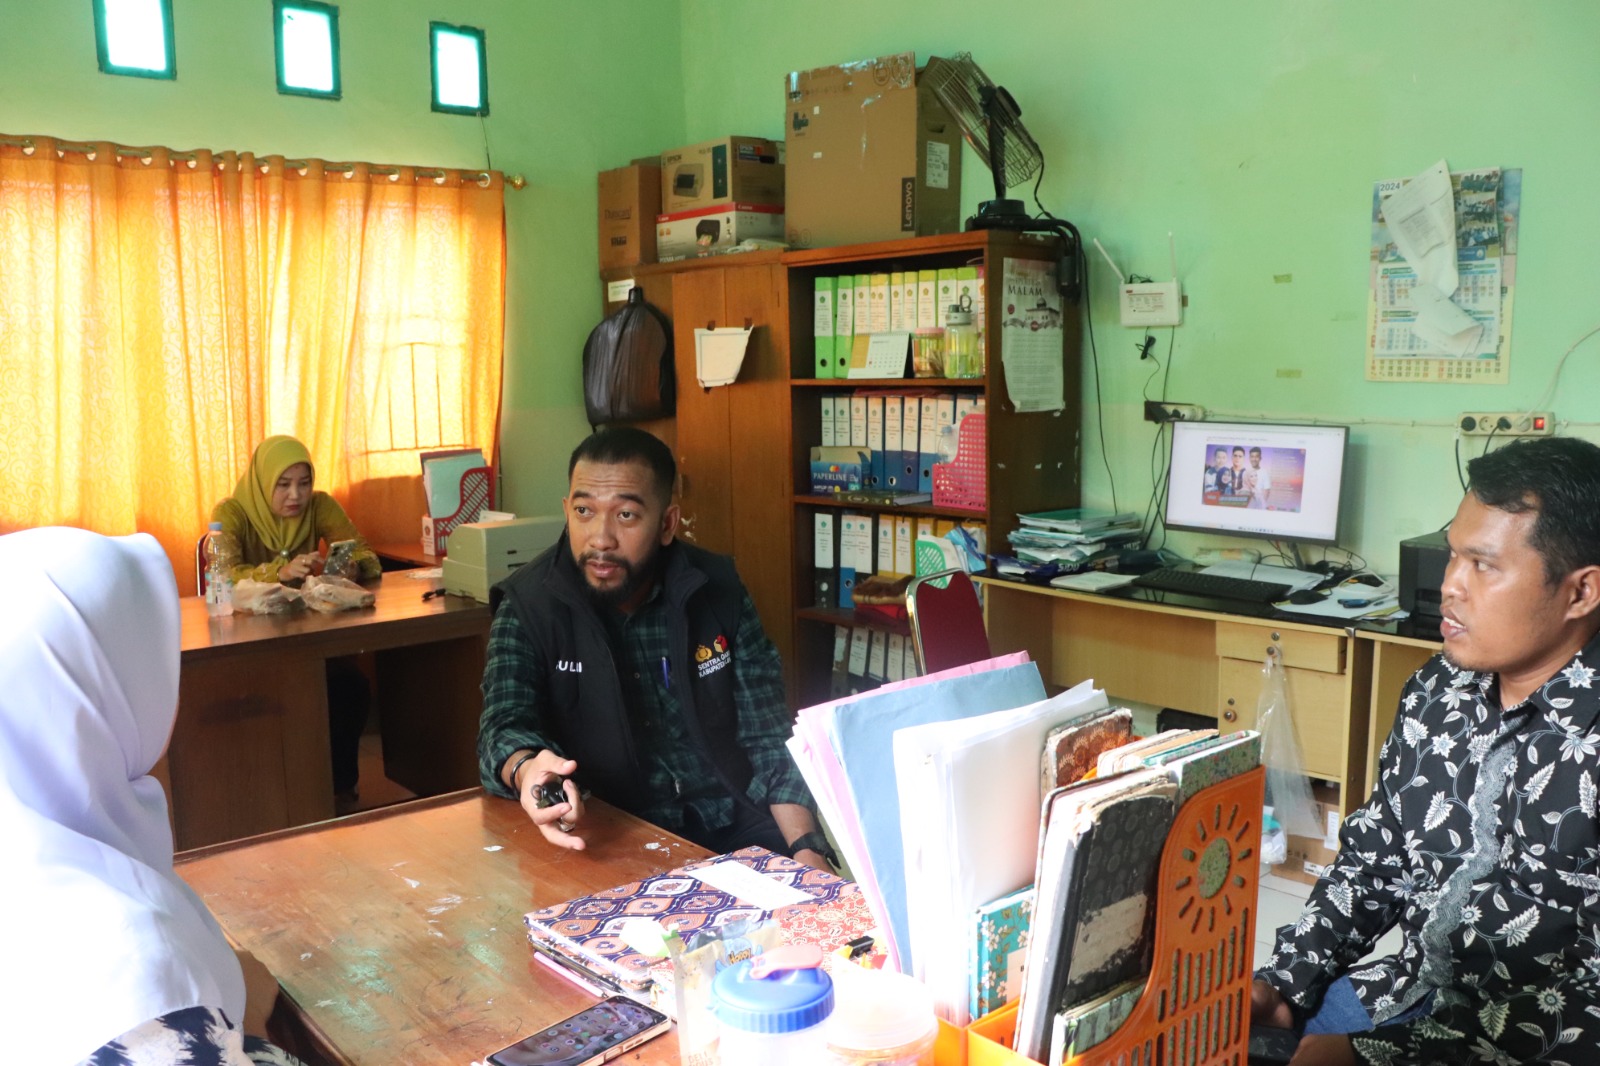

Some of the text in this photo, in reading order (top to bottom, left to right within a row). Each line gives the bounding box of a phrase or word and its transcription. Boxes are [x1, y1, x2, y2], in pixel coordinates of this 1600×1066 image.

[1380, 182, 1401, 191] 2024
[903, 181, 913, 231] Lenovo
[1008, 285, 1042, 297] MALAM
[813, 473, 847, 482] PAPERLINE
[1058, 563, 1081, 573] SIDU
[698, 657, 721, 671] SENTRA
